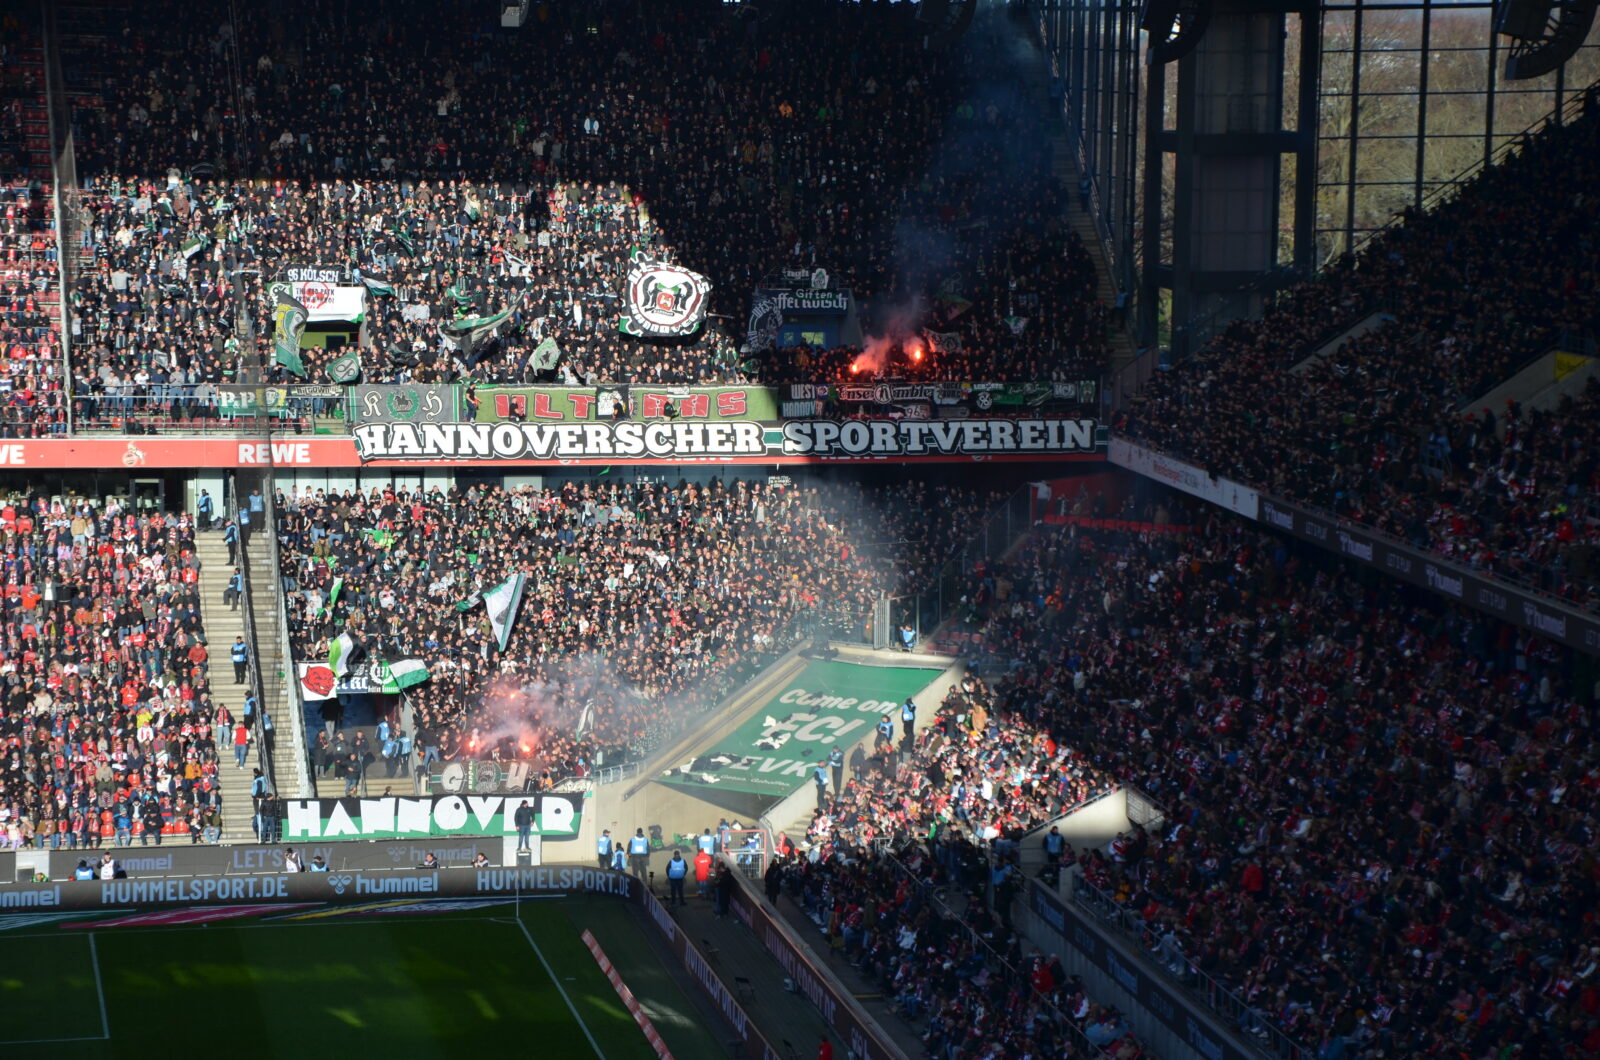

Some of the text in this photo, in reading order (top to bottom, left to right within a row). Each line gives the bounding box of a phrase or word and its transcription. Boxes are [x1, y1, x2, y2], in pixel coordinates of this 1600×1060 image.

[356, 419, 1095, 456] HANNOVERSCHER SPORTVEREIN
[238, 444, 311, 464] REWE
[729, 755, 819, 777] EVK
[286, 795, 575, 837] HANNOVER
[119, 853, 172, 872] ummel
[233, 849, 283, 869] LET'S
[409, 844, 476, 861] hummel
[101, 875, 288, 904] HUMMELSPORT.DE
[356, 872, 439, 894] hummel
[477, 869, 631, 898] HUMMELSPORT.DE
